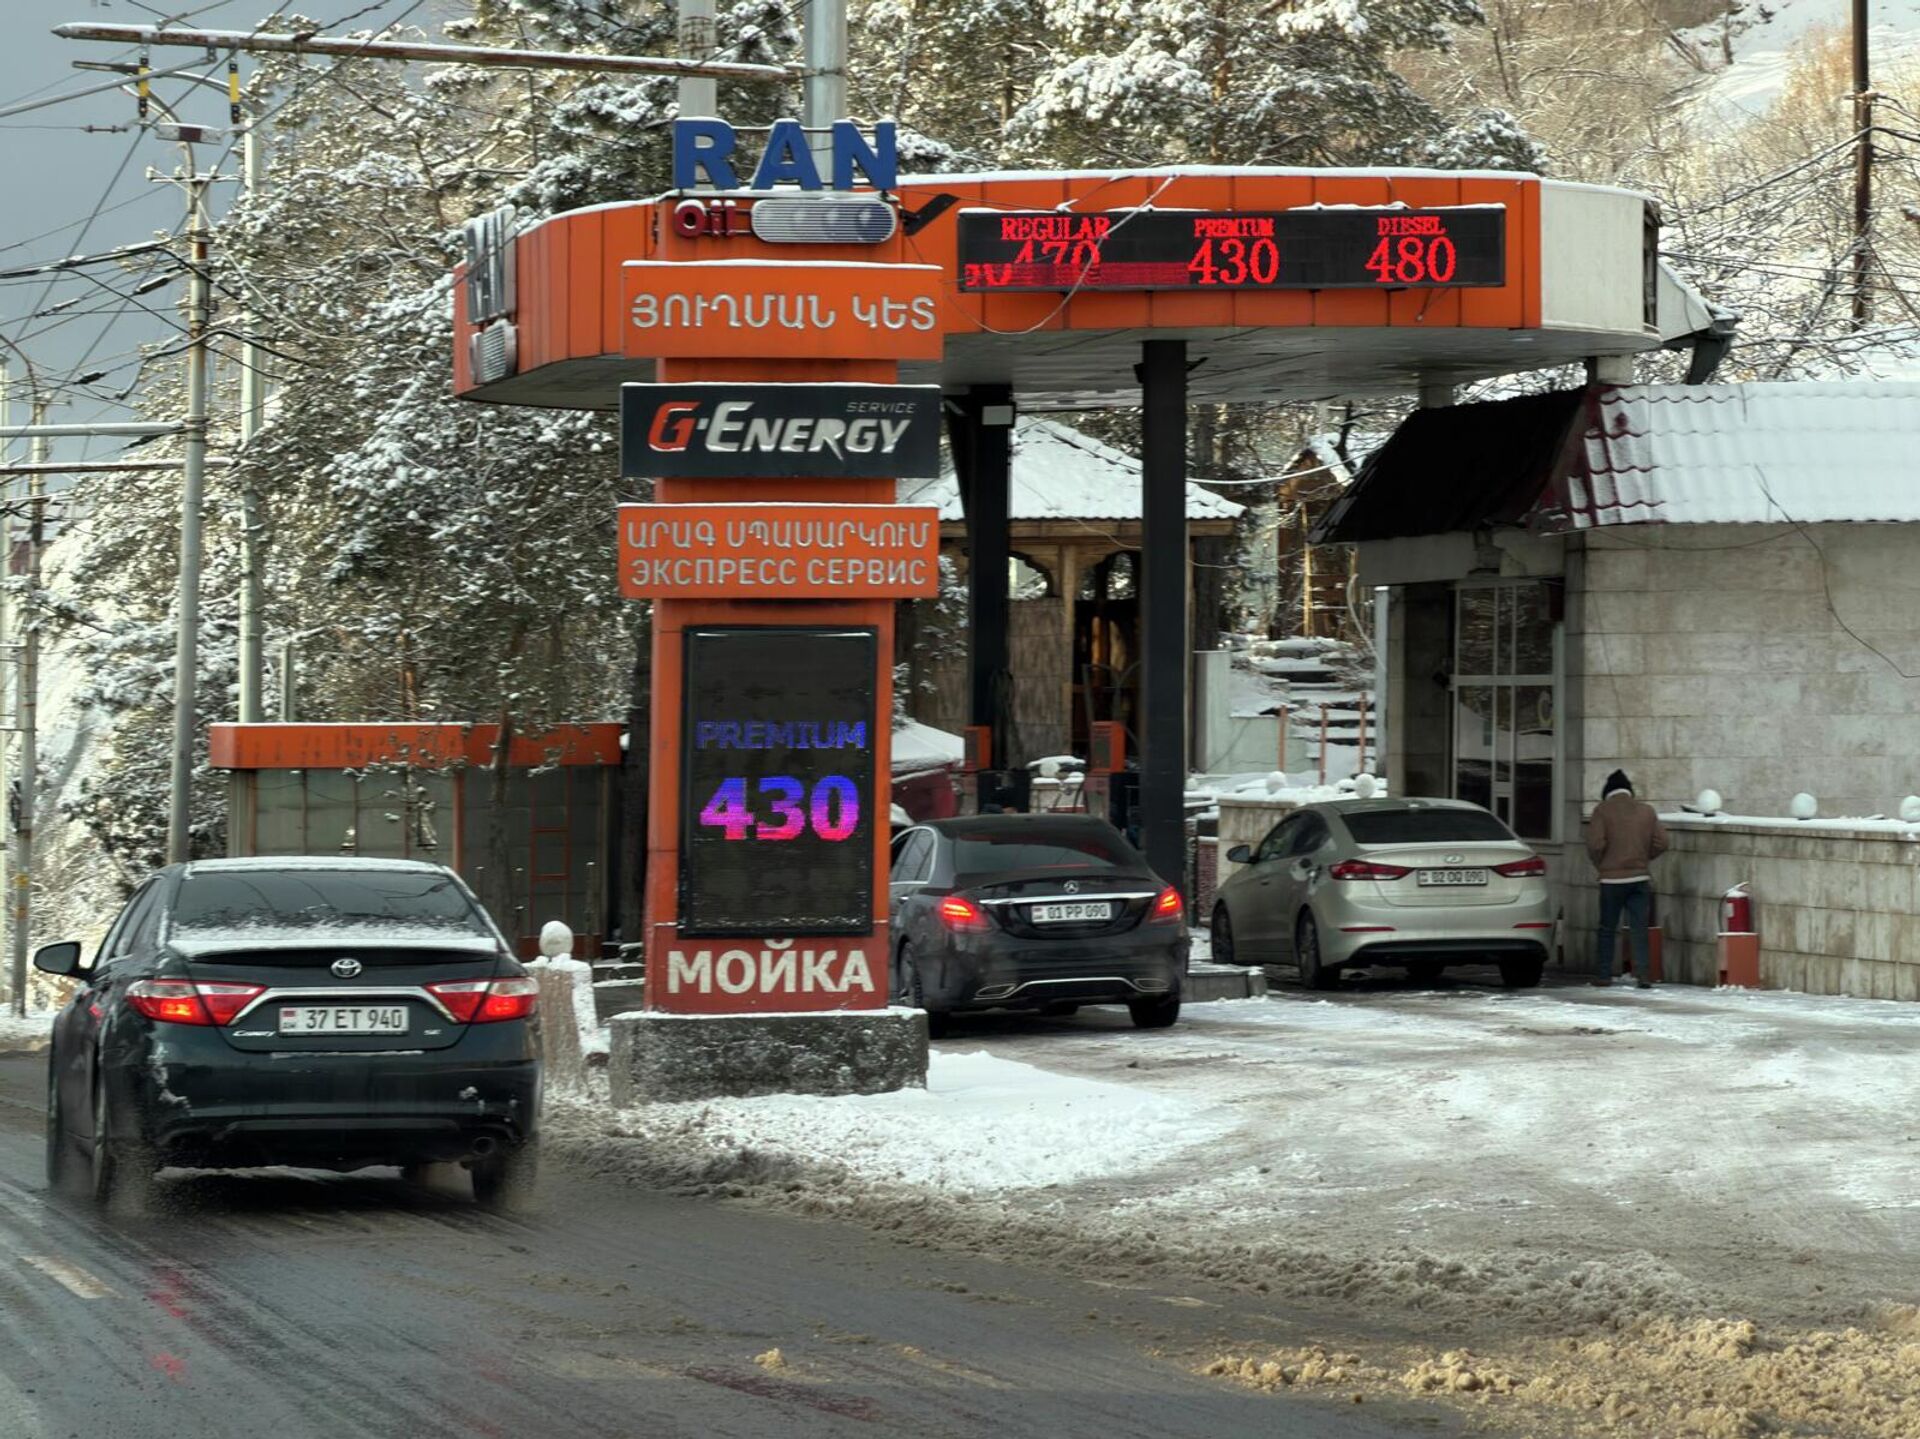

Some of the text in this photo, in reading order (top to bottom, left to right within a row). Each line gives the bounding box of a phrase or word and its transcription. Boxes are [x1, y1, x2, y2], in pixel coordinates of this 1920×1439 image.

[673, 118, 897, 190] RAN
[1001, 217, 1111, 240] REGULAR
[1194, 218, 1274, 237] PREMIUM
[1377, 216, 1446, 236] DIESEL
[1187, 238, 1280, 284] 430
[1365, 236, 1456, 283] 480
[631, 294, 936, 331] ՅՈՒՂՄԱՆ ԿԵՏ
[846, 402, 917, 414] SERVICE
[627, 520, 930, 549] ԱՐԱԳ ՍՊԱՍԱՐԿՈՒՄ
[630, 559, 927, 585] ЭКСПРЕСС СЕРВИС
[696, 720, 867, 749] PREMIUM
[700, 775, 860, 841] 430
[1065, 905, 1082, 918] PP
[667, 939, 875, 994] МОЙКА
[306, 1009, 329, 1029] 37
[336, 1009, 361, 1029] ET
[368, 1009, 402, 1029] 940
